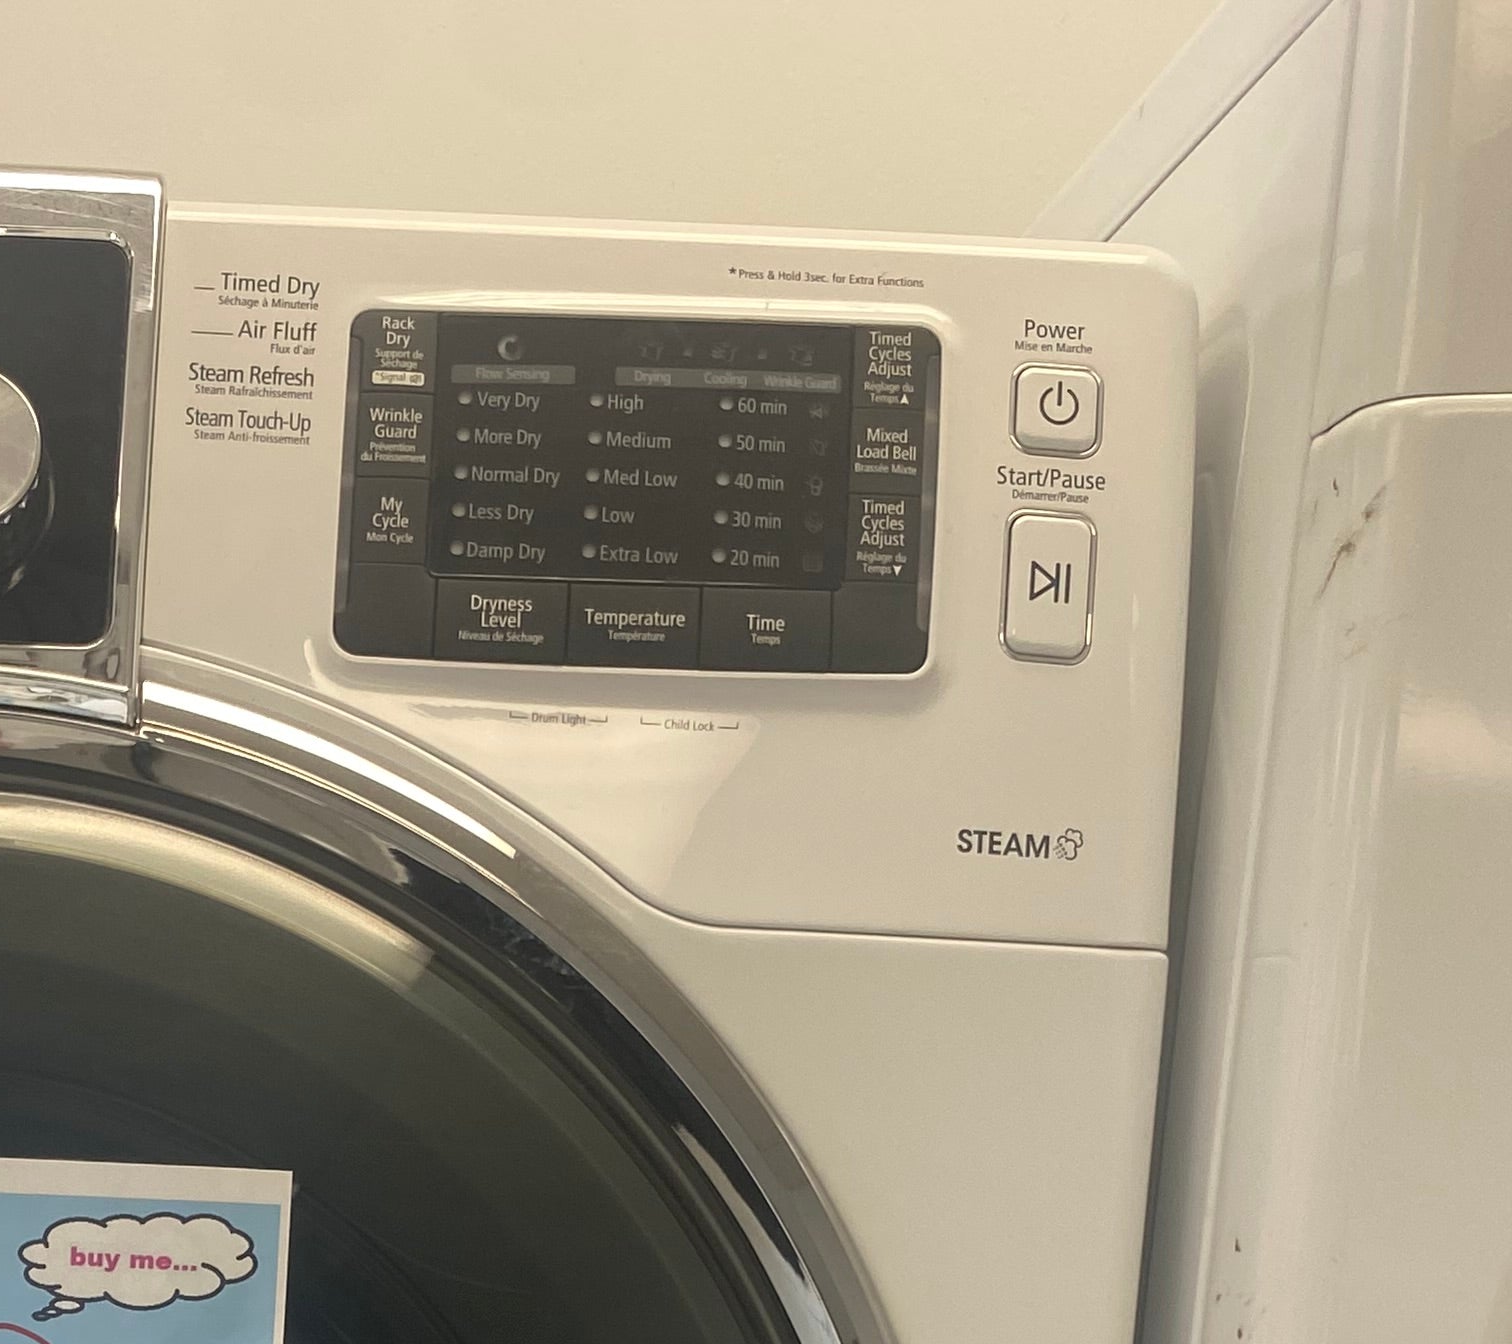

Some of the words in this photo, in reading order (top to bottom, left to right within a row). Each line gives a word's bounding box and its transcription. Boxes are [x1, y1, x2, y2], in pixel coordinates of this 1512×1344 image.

[221, 272, 280, 293] Timed
[288, 277, 319, 300] Dry
[778, 271, 801, 282] Hold
[833, 273, 845, 284] for
[878, 276, 924, 288] Functions
[238, 320, 266, 339] Air
[274, 322, 317, 341] Fluff
[382, 317, 415, 330] Rack
[1025, 319, 1085, 340] Power
[386, 332, 410, 348] Dry
[870, 332, 911, 346] Timed
[1015, 341, 1037, 351] Mise
[869, 347, 911, 363] Cycles
[189, 363, 243, 383] Steam
[250, 366, 314, 387] Refresh
[868, 362, 912, 379] Adjust
[477, 392, 510, 408] Very
[516, 392, 540, 409] Dry
[607, 395, 643, 414] High
[738, 399, 757, 414] 60
[760, 400, 787, 415] min
[186, 407, 233, 427] Steam
[238, 409, 311, 435] Touch-Up
[370, 408, 422, 423] Wrinkle
[375, 425, 417, 439] Guard
[475, 429, 513, 444] More
[517, 430, 541, 448] Dry
[606, 432, 671, 449] Medium
[867, 428, 908, 443] Mixed
[736, 436, 755, 451] 50
[759, 438, 785, 452] min
[857, 446, 888, 459] Load
[893, 447, 916, 461] Bell
[472, 466, 528, 482] Normal
[534, 469, 560, 487] Dry
[604, 469, 639, 485] Med
[645, 471, 677, 487] Low
[734, 474, 754, 488] 40
[757, 476, 784, 490] min
[997, 466, 1105, 490] Start/Pause
[381, 497, 403, 516] My
[468, 504, 502, 520] Less
[508, 506, 534, 524] Dry
[602, 507, 634, 523] Low
[862, 500, 904, 515] Timed
[373, 512, 409, 531] Cycle
[732, 511, 751, 527] 30
[755, 513, 781, 529] min
[861, 517, 904, 533] Cycles
[860, 533, 904, 548] Adjust
[467, 542, 513, 561] Damp
[519, 544, 545, 563] Dry
[600, 545, 640, 561] Extra
[646, 547, 678, 564] Low
[730, 551, 749, 566] 20
[753, 552, 779, 568] min
[471, 595, 532, 614] Dryness
[481, 612, 521, 628] Level
[585, 609, 685, 629] Temperature
[747, 614, 785, 631] Time
[664, 720, 688, 730] Child
[693, 721, 714, 731] Lock
[957, 829, 1050, 859] STEAM
[70, 1247, 120, 1270] buy
[129, 1252, 197, 1271] me...
